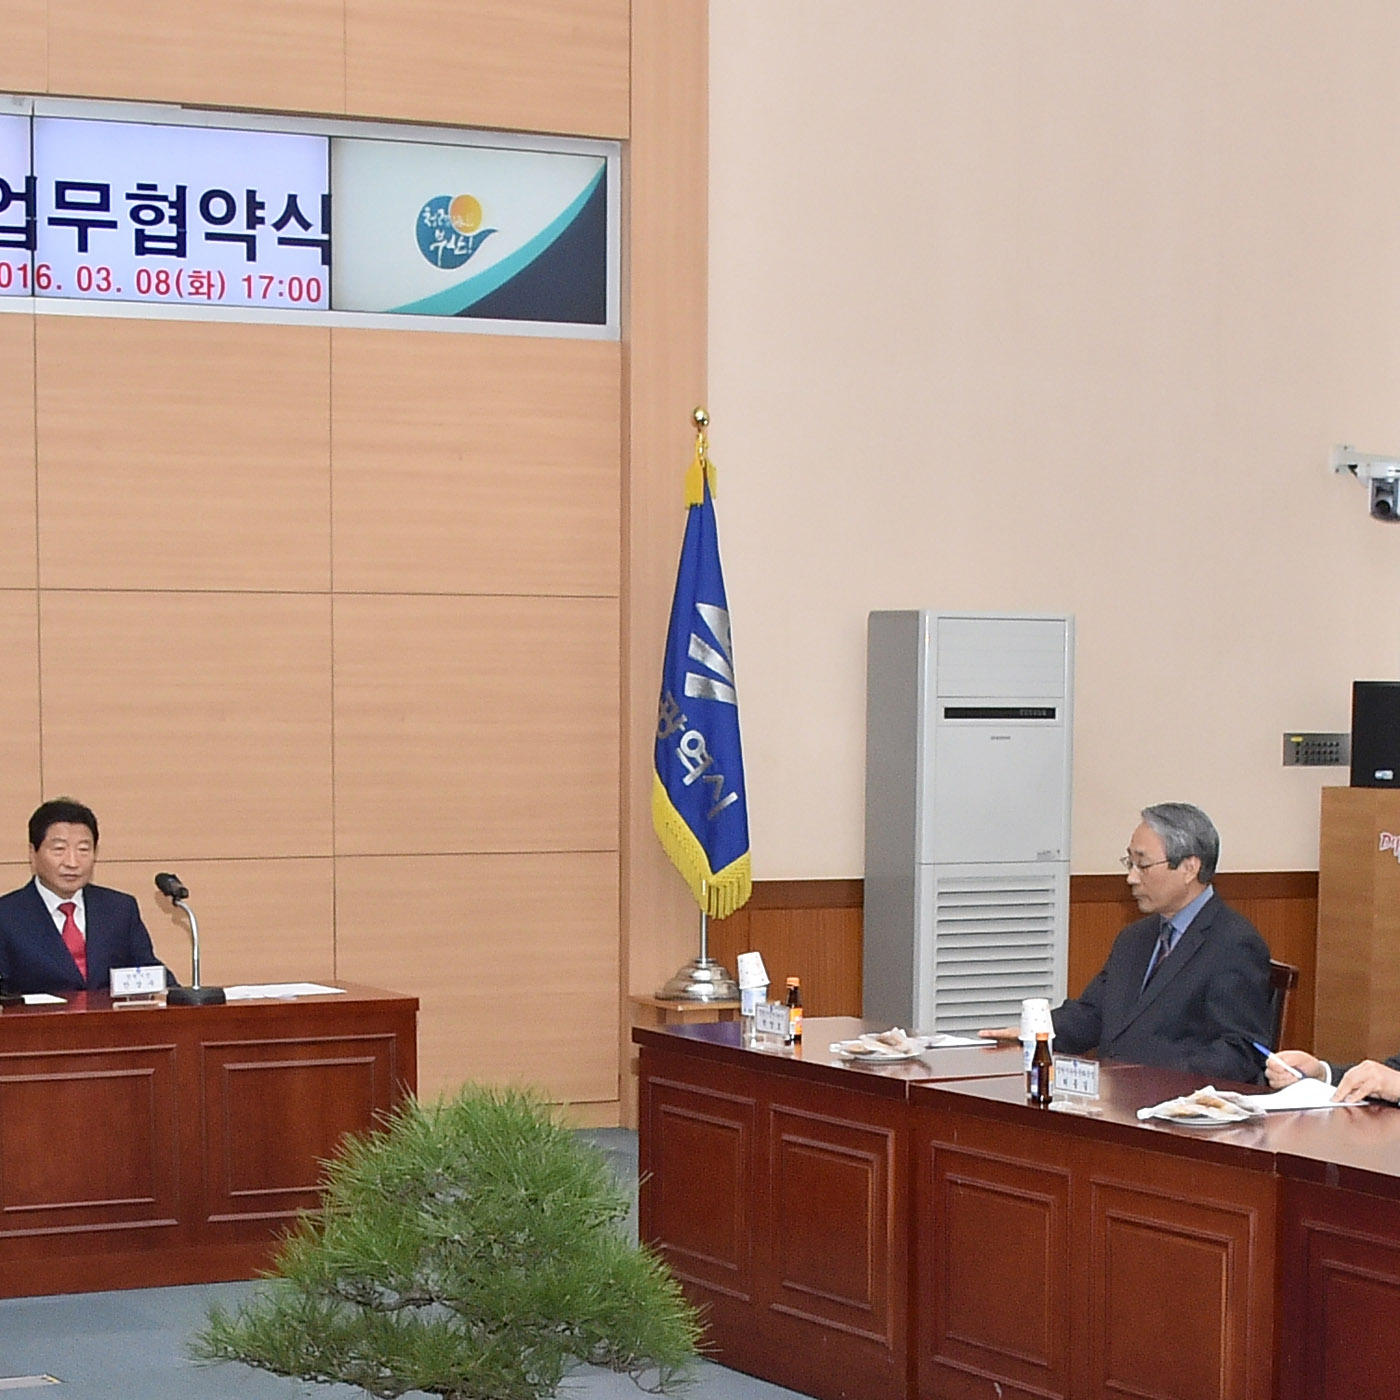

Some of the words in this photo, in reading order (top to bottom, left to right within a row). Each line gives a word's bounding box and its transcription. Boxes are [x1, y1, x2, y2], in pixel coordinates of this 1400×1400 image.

[76, 266, 122, 294] 03.
[135, 268, 227, 301] 08(화)
[242, 274, 323, 304] 17:00
